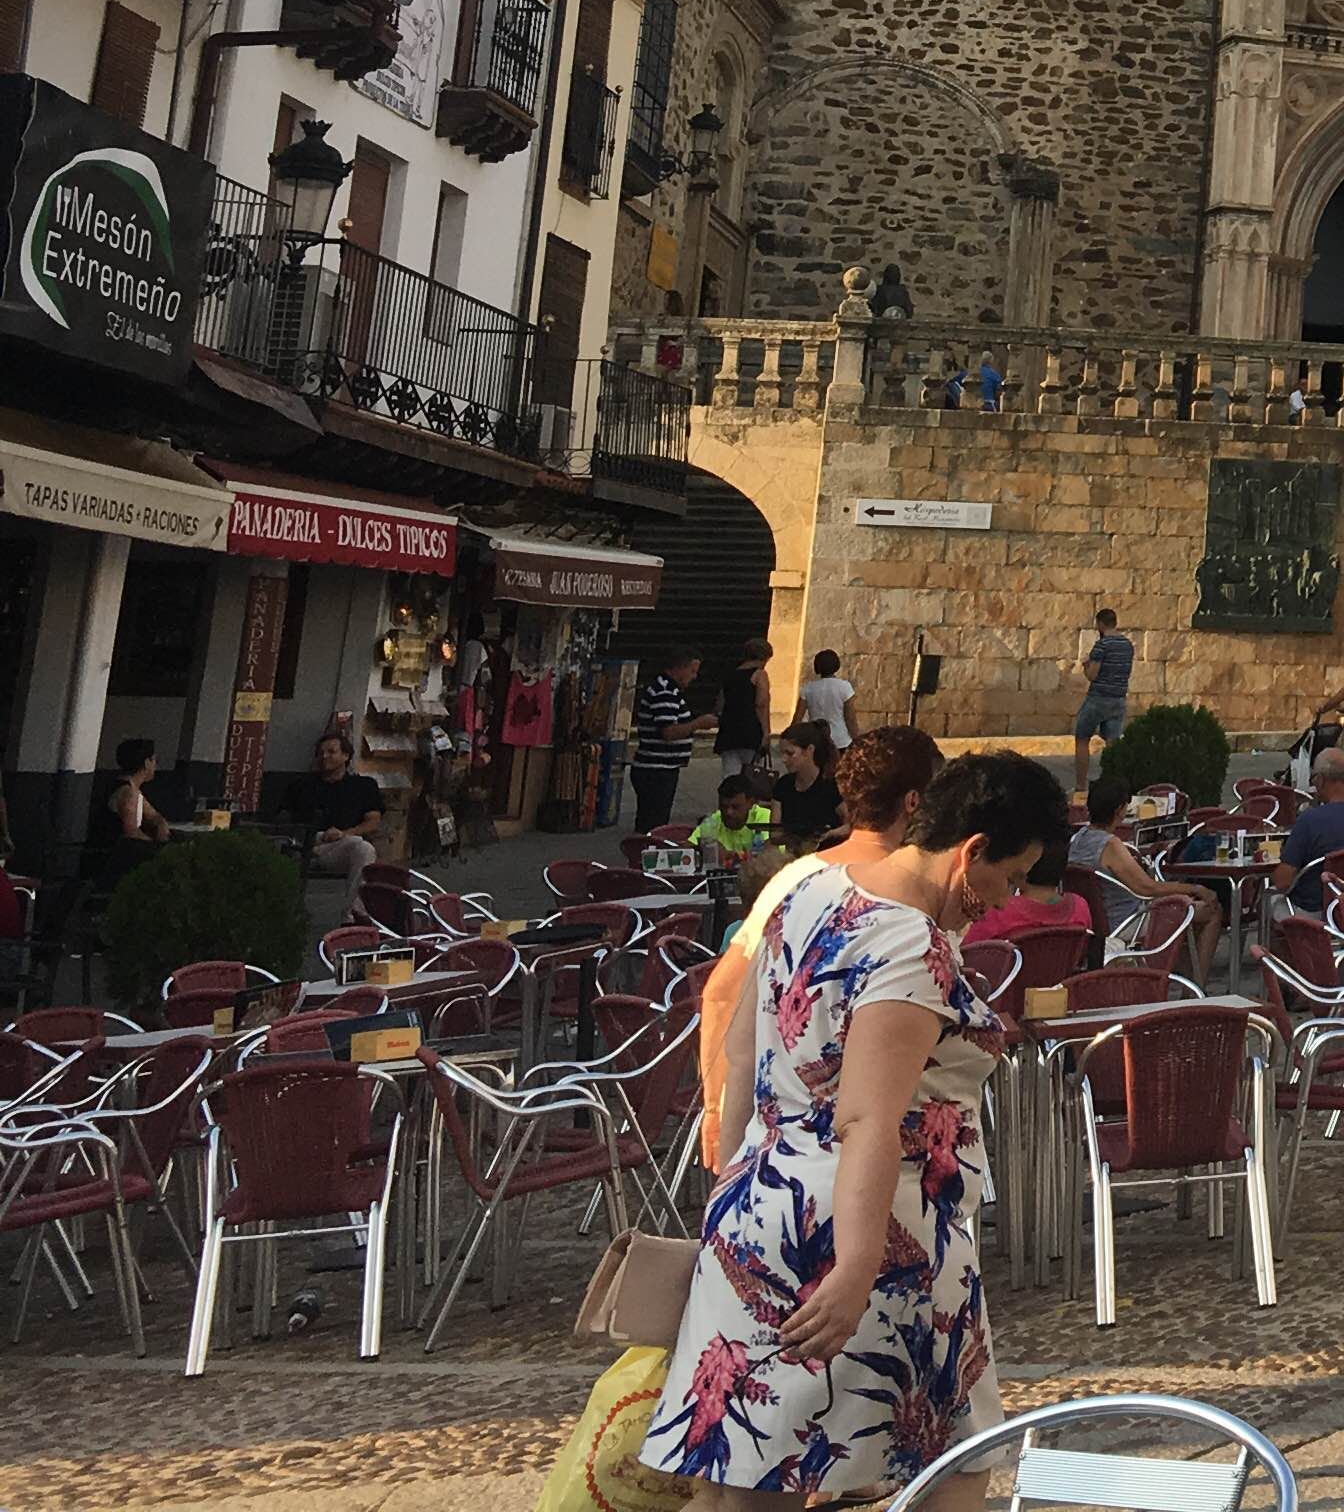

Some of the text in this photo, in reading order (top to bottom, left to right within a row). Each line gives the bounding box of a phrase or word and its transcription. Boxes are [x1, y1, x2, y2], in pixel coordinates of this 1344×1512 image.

[69, 186, 152, 262] Mesón
[43, 230, 181, 322] Extremeño
[25, 482, 68, 512] TAPAS
[72, 491, 134, 524] VARIADAS
[143, 506, 199, 536] RACIONES
[337, 514, 392, 552] DULCES
[397, 524, 448, 559] TIPICOS
[550, 571, 573, 595] JUAN
[573, 573, 614, 598] PODEROSO
